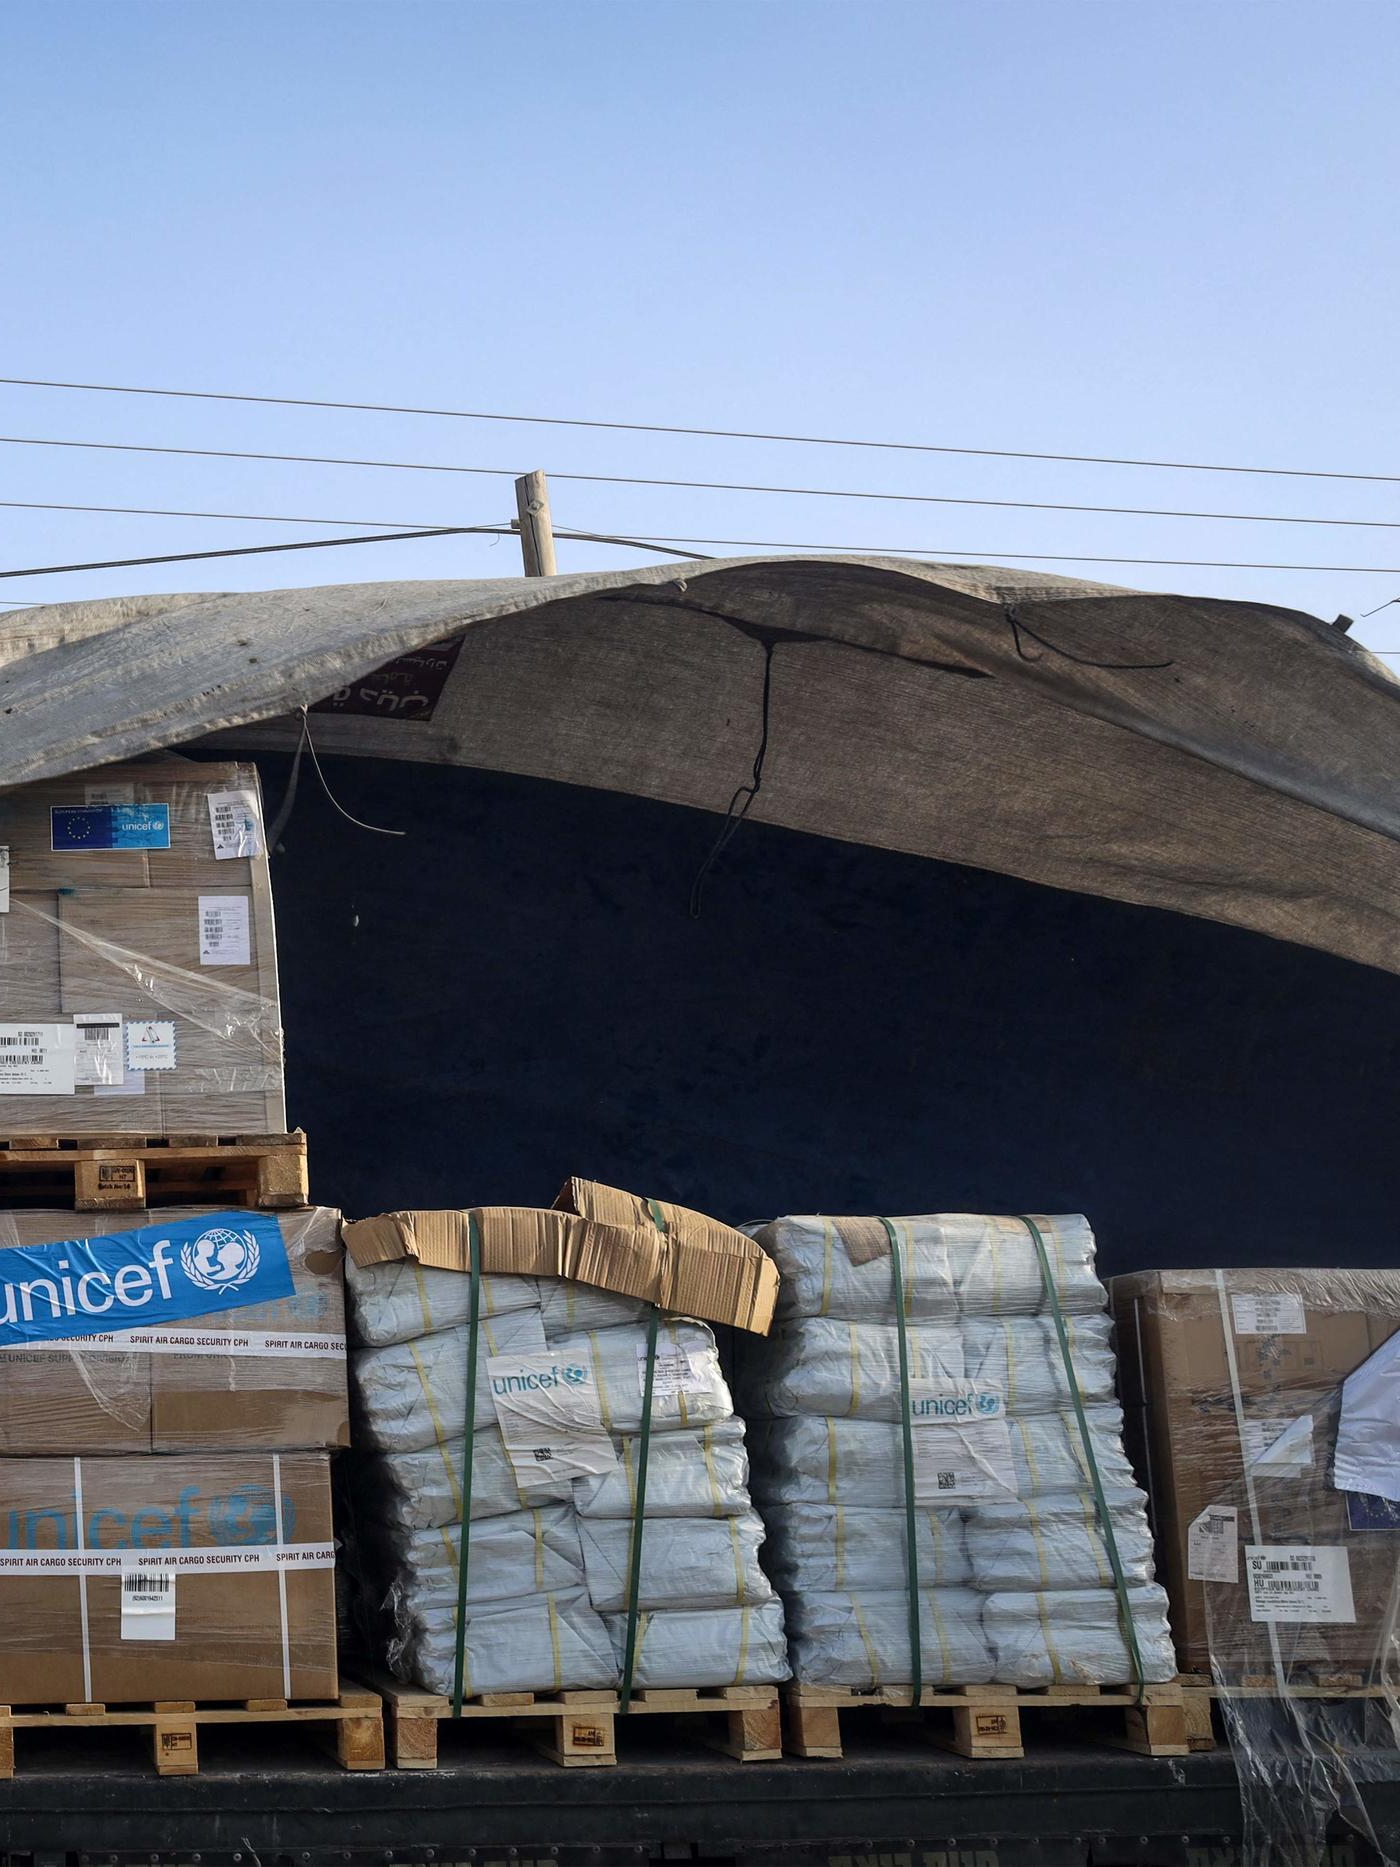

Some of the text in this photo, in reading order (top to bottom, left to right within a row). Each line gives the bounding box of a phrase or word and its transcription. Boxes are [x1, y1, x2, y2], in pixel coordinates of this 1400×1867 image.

[122, 821, 151, 832] unicef
[98, 1335, 114, 1343] CPH
[130, 1335, 249, 1347] SPIRIT AIR CARGO SECURITY CPH
[264, 1340, 347, 1351] SPIRIT AIR CARGO SEC
[493, 1366, 560, 1395] unicef
[912, 1393, 974, 1416] unicef
[0, 1558, 122, 1567] SPIRIT AIR CARGO SECURITY CPH
[138, 1554, 260, 1566] SPIRIT AIR CARGO SECURITY CPH
[276, 1553, 300, 1562] SPIRIT
[302, 1552, 315, 1560] AIR
[1252, 1560, 1262, 1570] SU
[1254, 1579, 1264, 1588] HU
